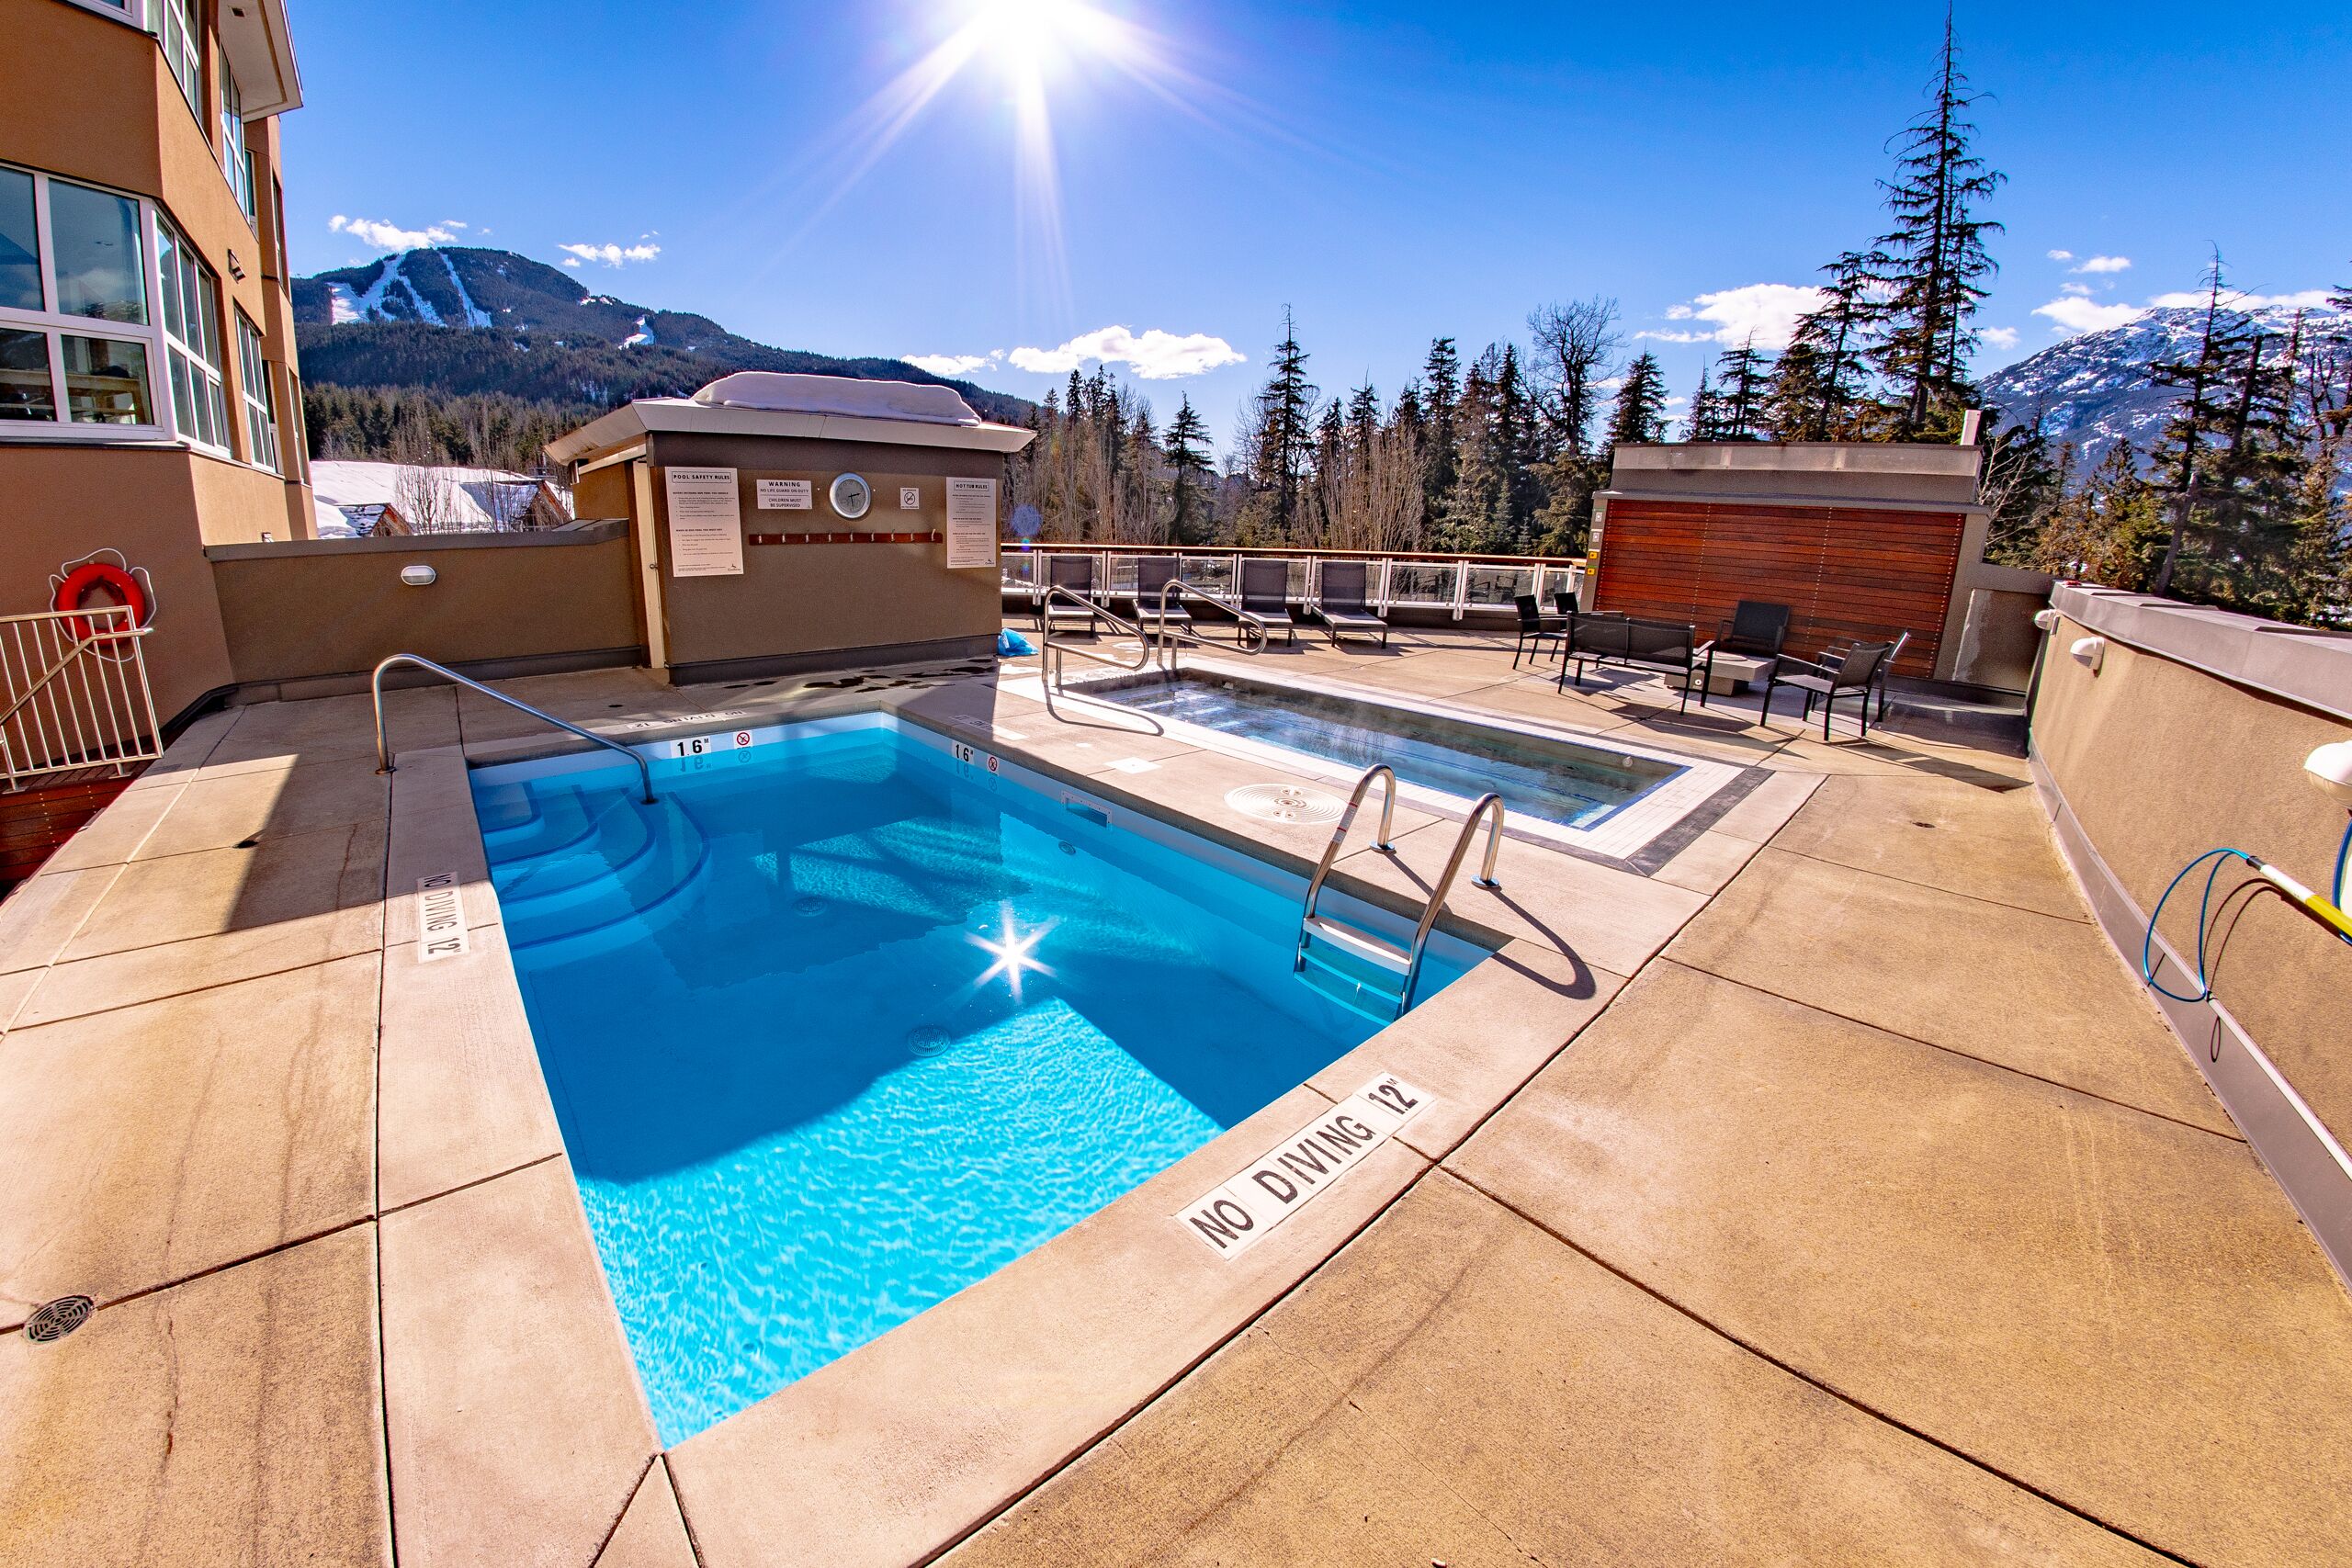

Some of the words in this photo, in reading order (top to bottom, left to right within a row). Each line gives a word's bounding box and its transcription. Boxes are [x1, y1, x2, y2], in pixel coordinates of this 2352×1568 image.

[424, 874, 451, 887] NO
[424, 890, 458, 931] DIVING
[1189, 1200, 1254, 1249] NO
[1251, 1115, 1376, 1204] DIVING
